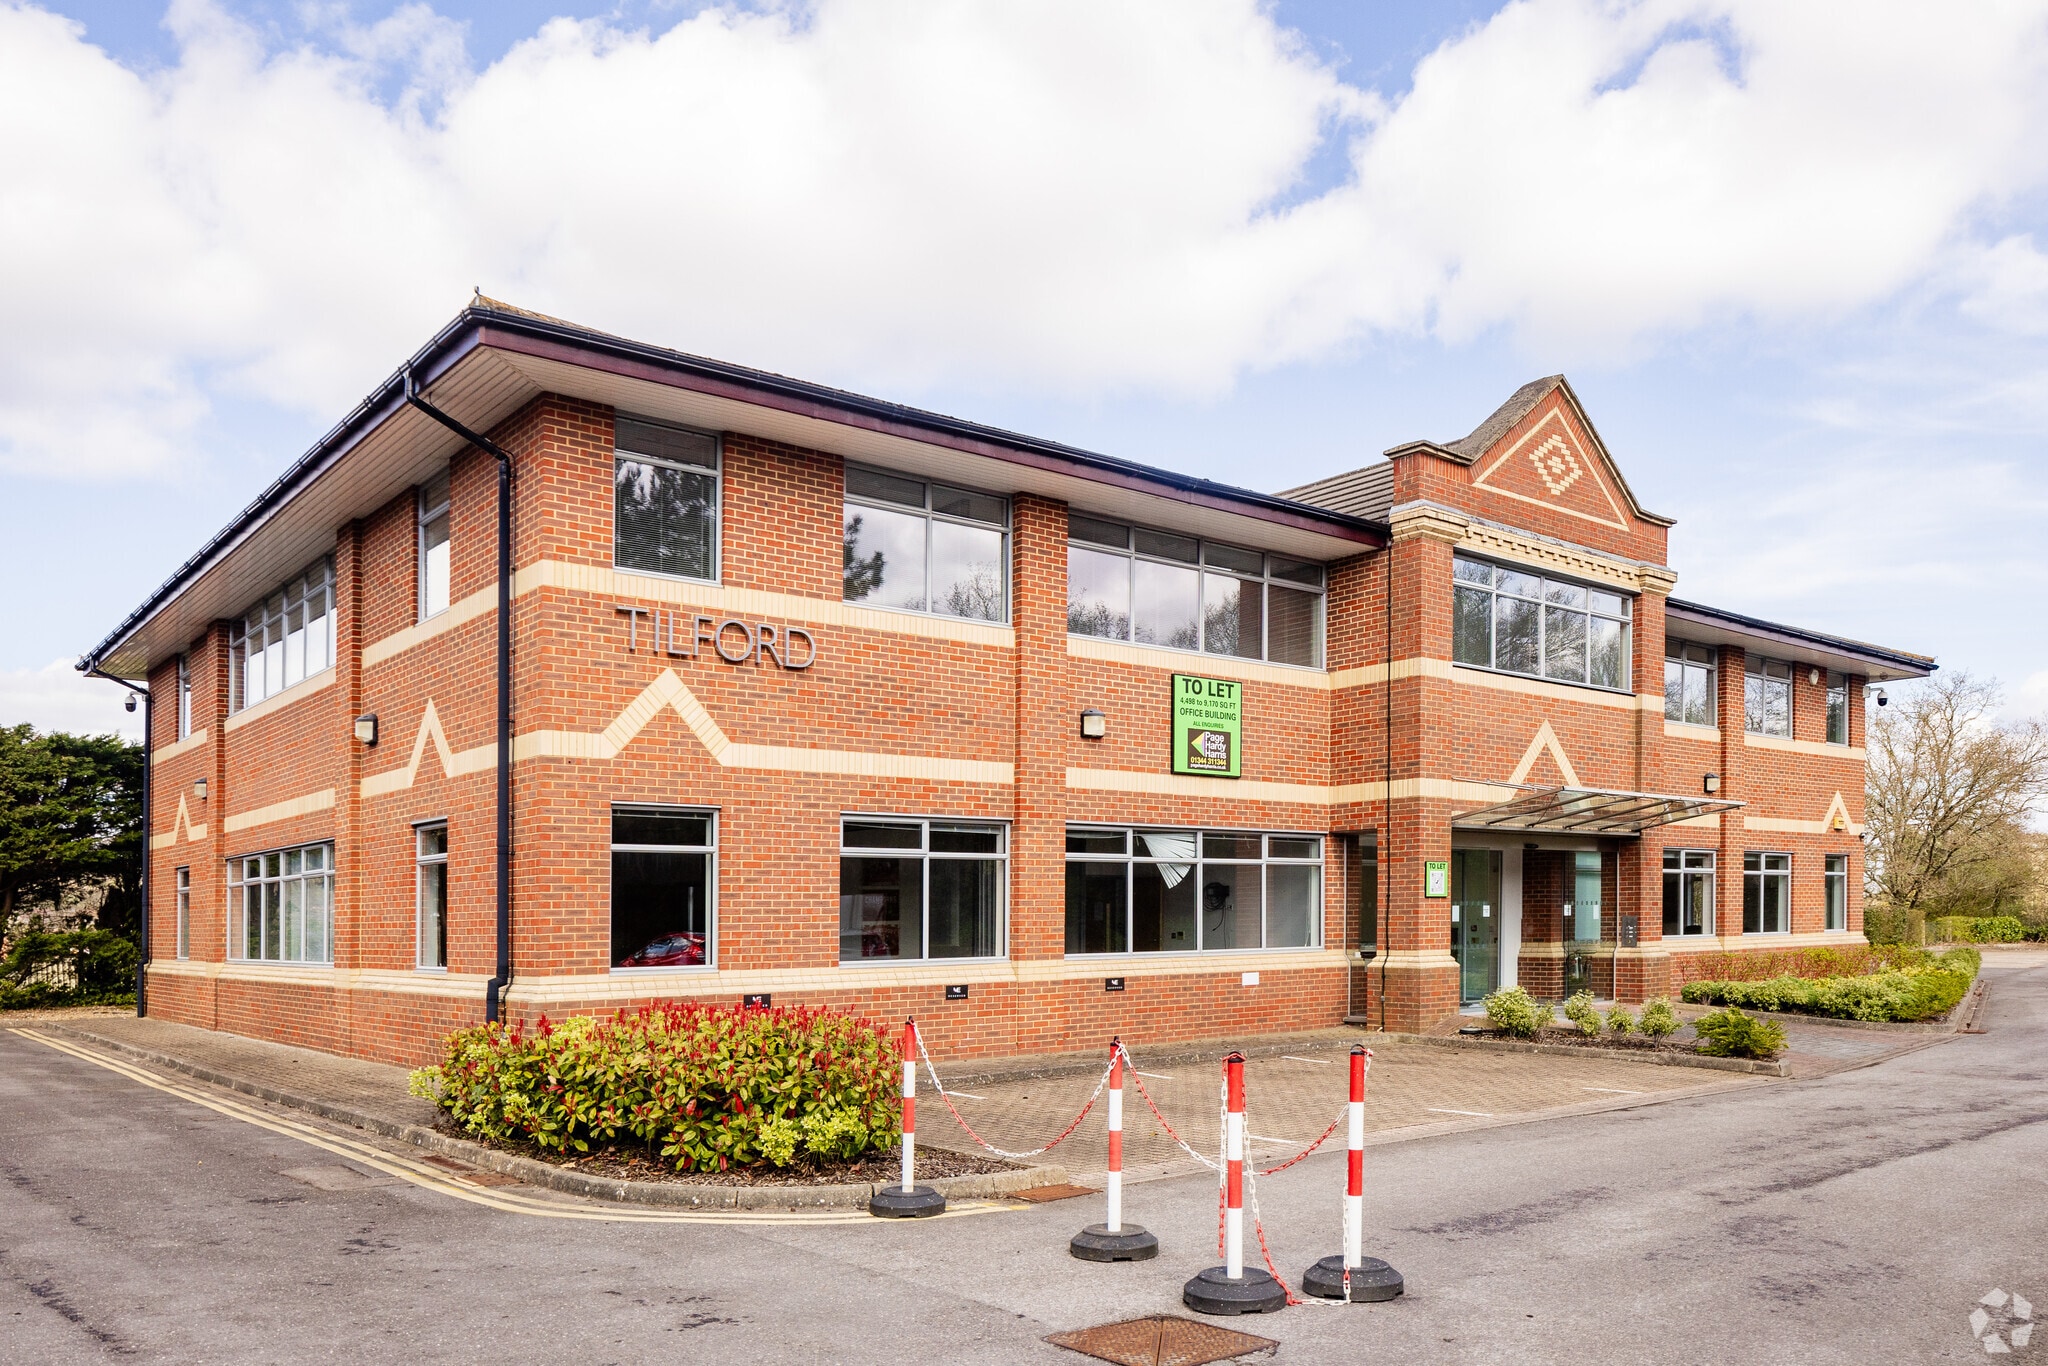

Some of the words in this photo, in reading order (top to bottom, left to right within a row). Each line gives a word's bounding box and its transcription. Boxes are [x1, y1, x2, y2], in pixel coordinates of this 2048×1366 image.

[615, 605, 817, 668] TILFORD
[1182, 678, 1203, 695] TO
[1208, 681, 1235, 698] LET
[1219, 701, 1228, 709] SQ
[1179, 707, 1203, 717] OFFICE
[1204, 710, 1237, 721] BUILDING
[1205, 731, 1225, 743] Page
[1205, 741, 1226, 752] Hardy
[1205, 749, 1227, 759] Harris
[1190, 756, 1207, 764] 01344
[1207, 758, 1227, 766] 311344
